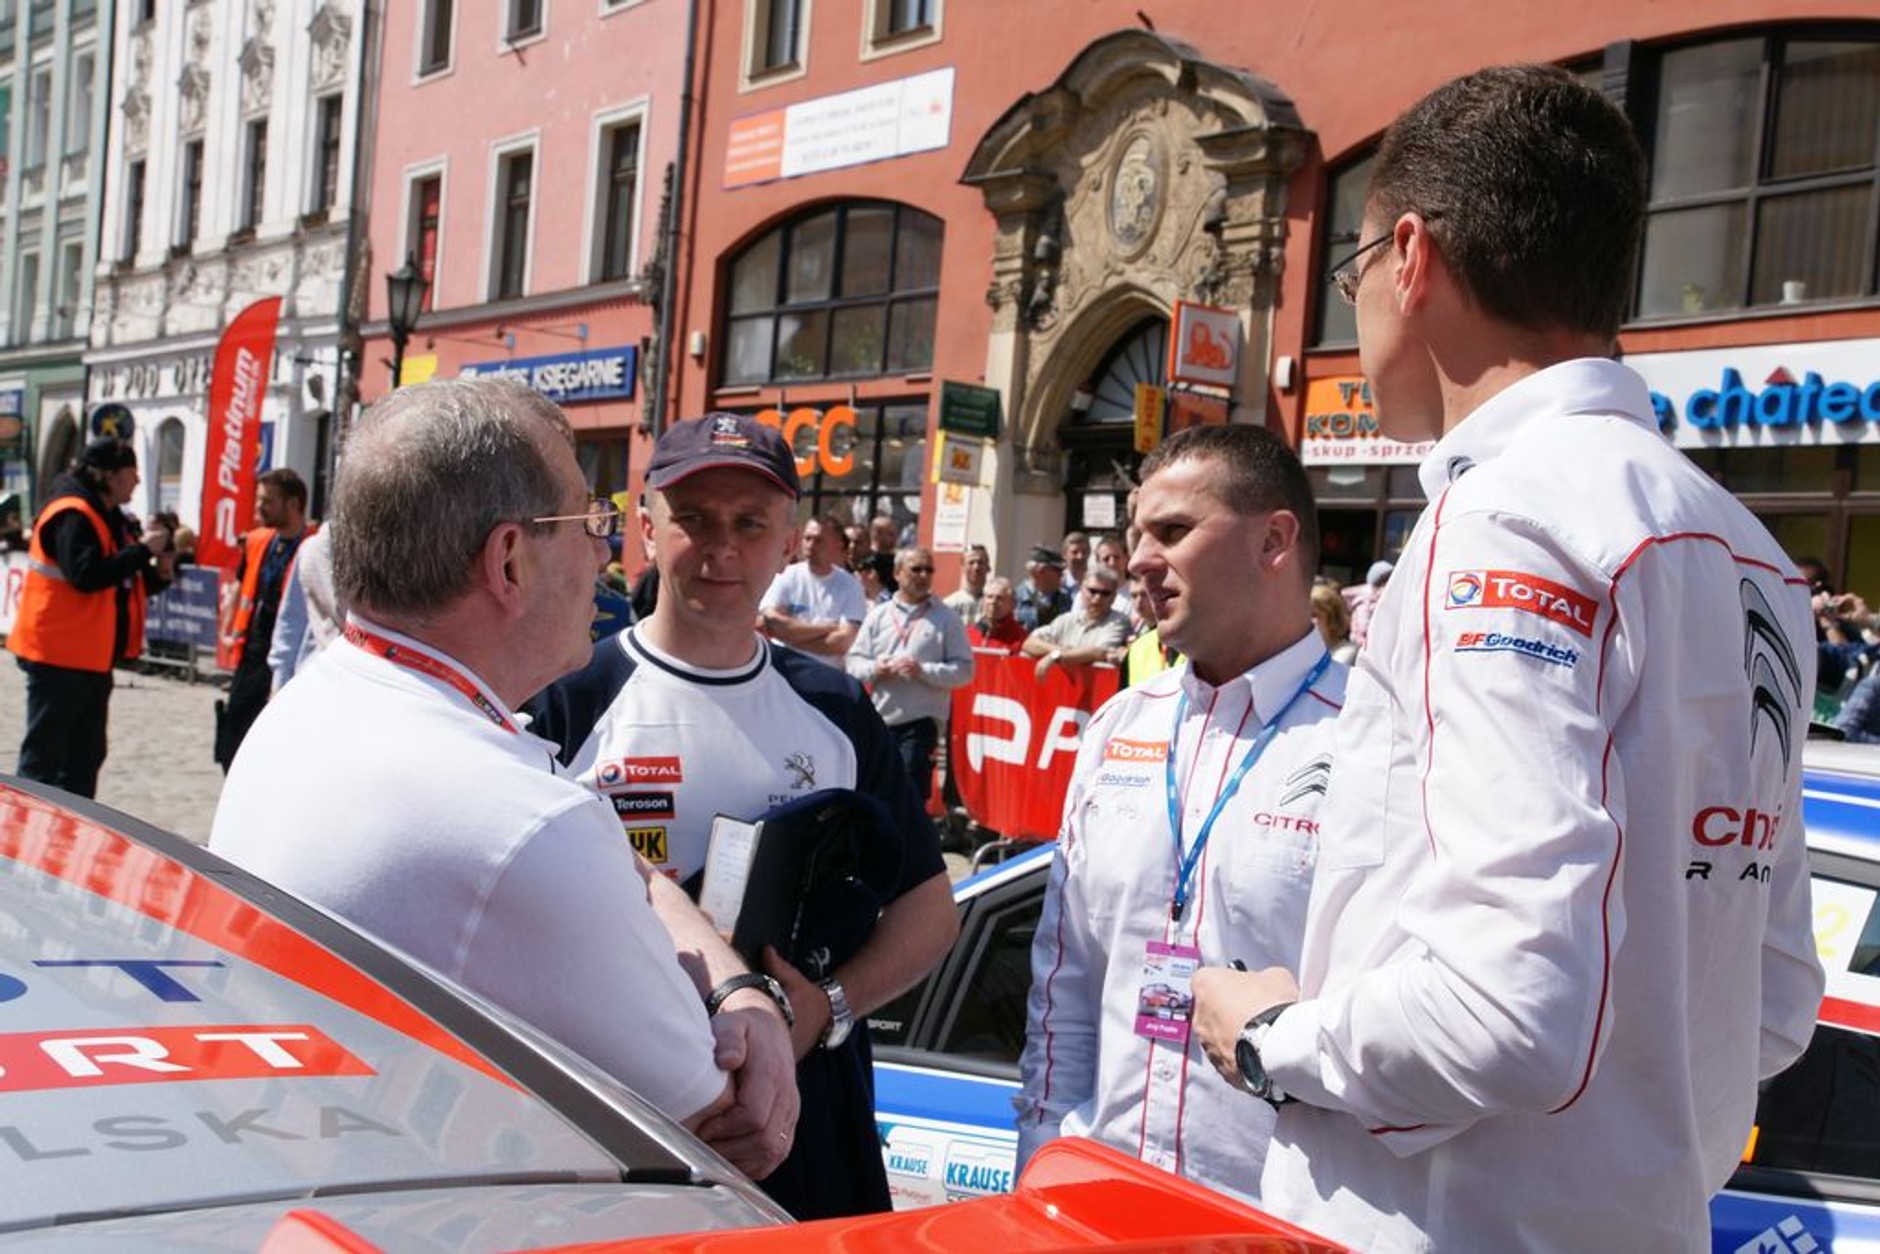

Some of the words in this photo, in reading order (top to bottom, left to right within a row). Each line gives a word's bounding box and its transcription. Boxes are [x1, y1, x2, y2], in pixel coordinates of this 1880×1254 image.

[217, 345, 255, 494] Platinum
[1491, 577, 1589, 627] TOTAL
[1456, 632, 1580, 664] BFGoodrich
[1110, 741, 1166, 759] TOTAL
[626, 764, 682, 777] TOTAL
[614, 797, 668, 810] Teroson
[888, 1154, 928, 1175] KRAUSE
[946, 1162, 1010, 1193] KRAUSE
